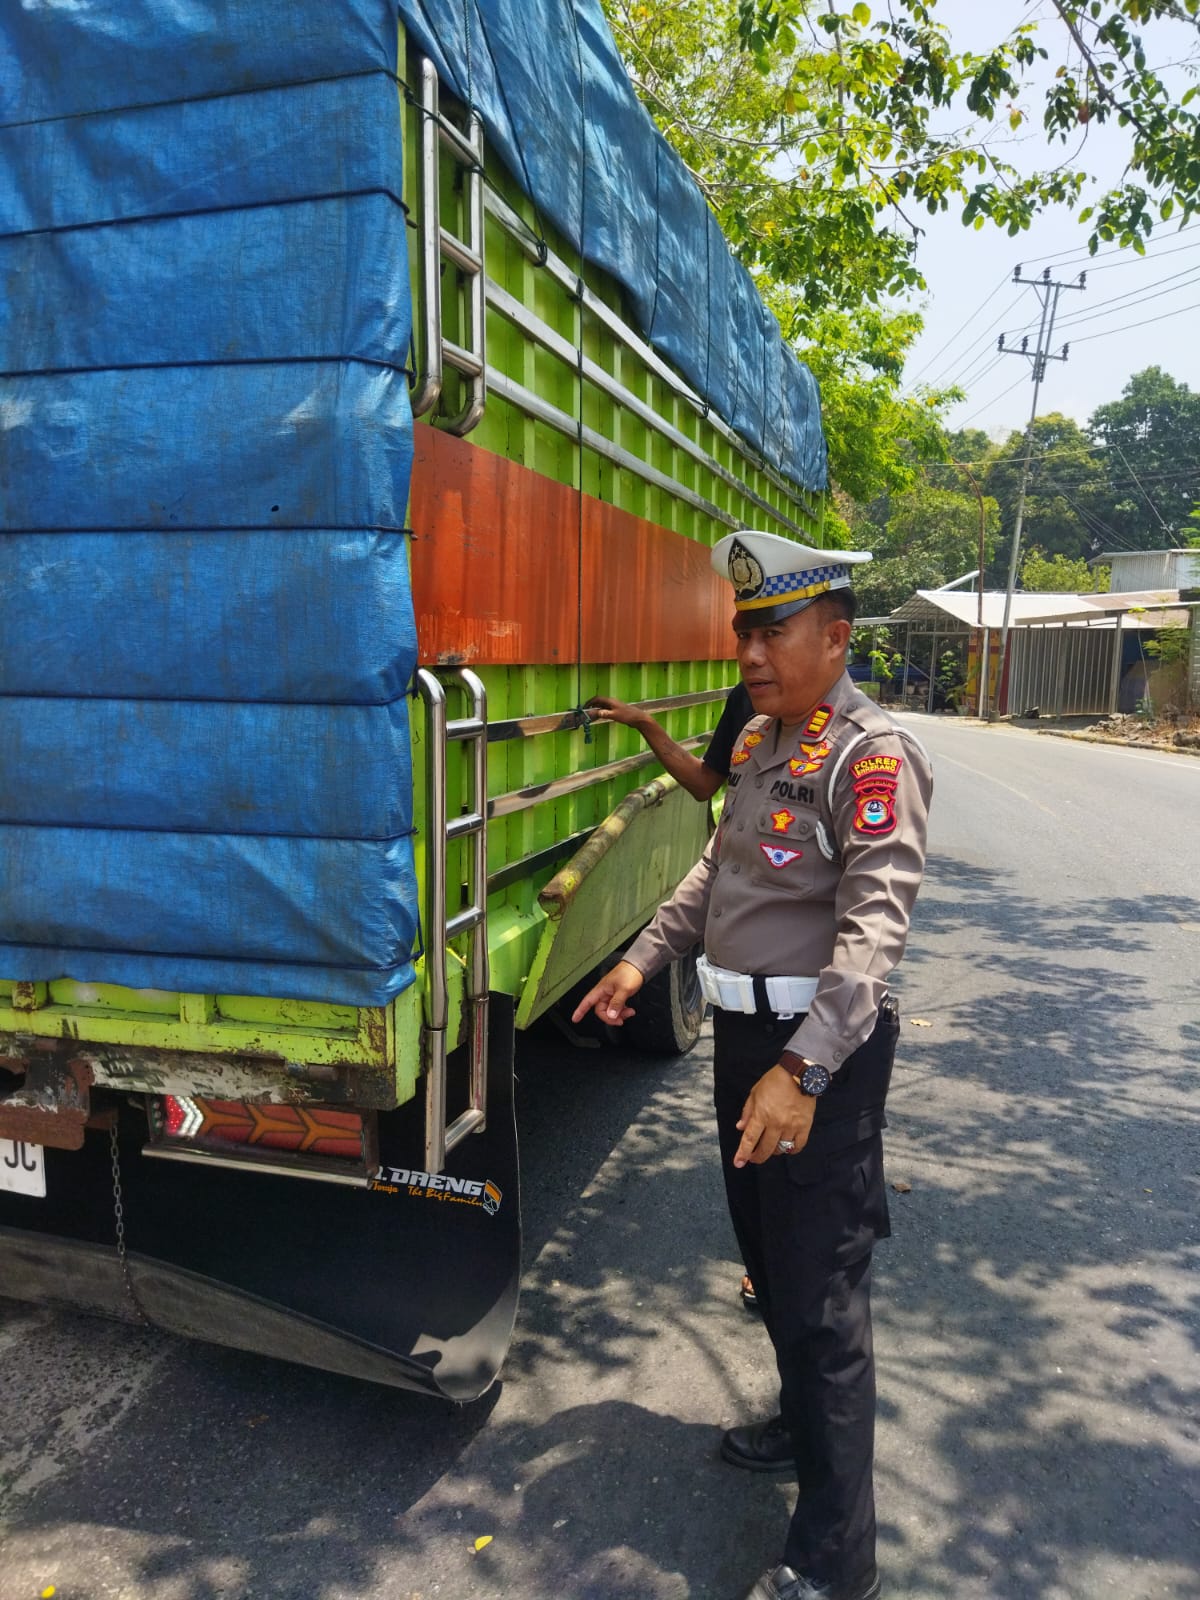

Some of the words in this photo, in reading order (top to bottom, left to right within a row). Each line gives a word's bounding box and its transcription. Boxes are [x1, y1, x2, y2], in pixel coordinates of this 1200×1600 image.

[854, 757, 898, 771] POLRES
[770, 780, 814, 804] POLRI
[408, 1185, 423, 1196] The
